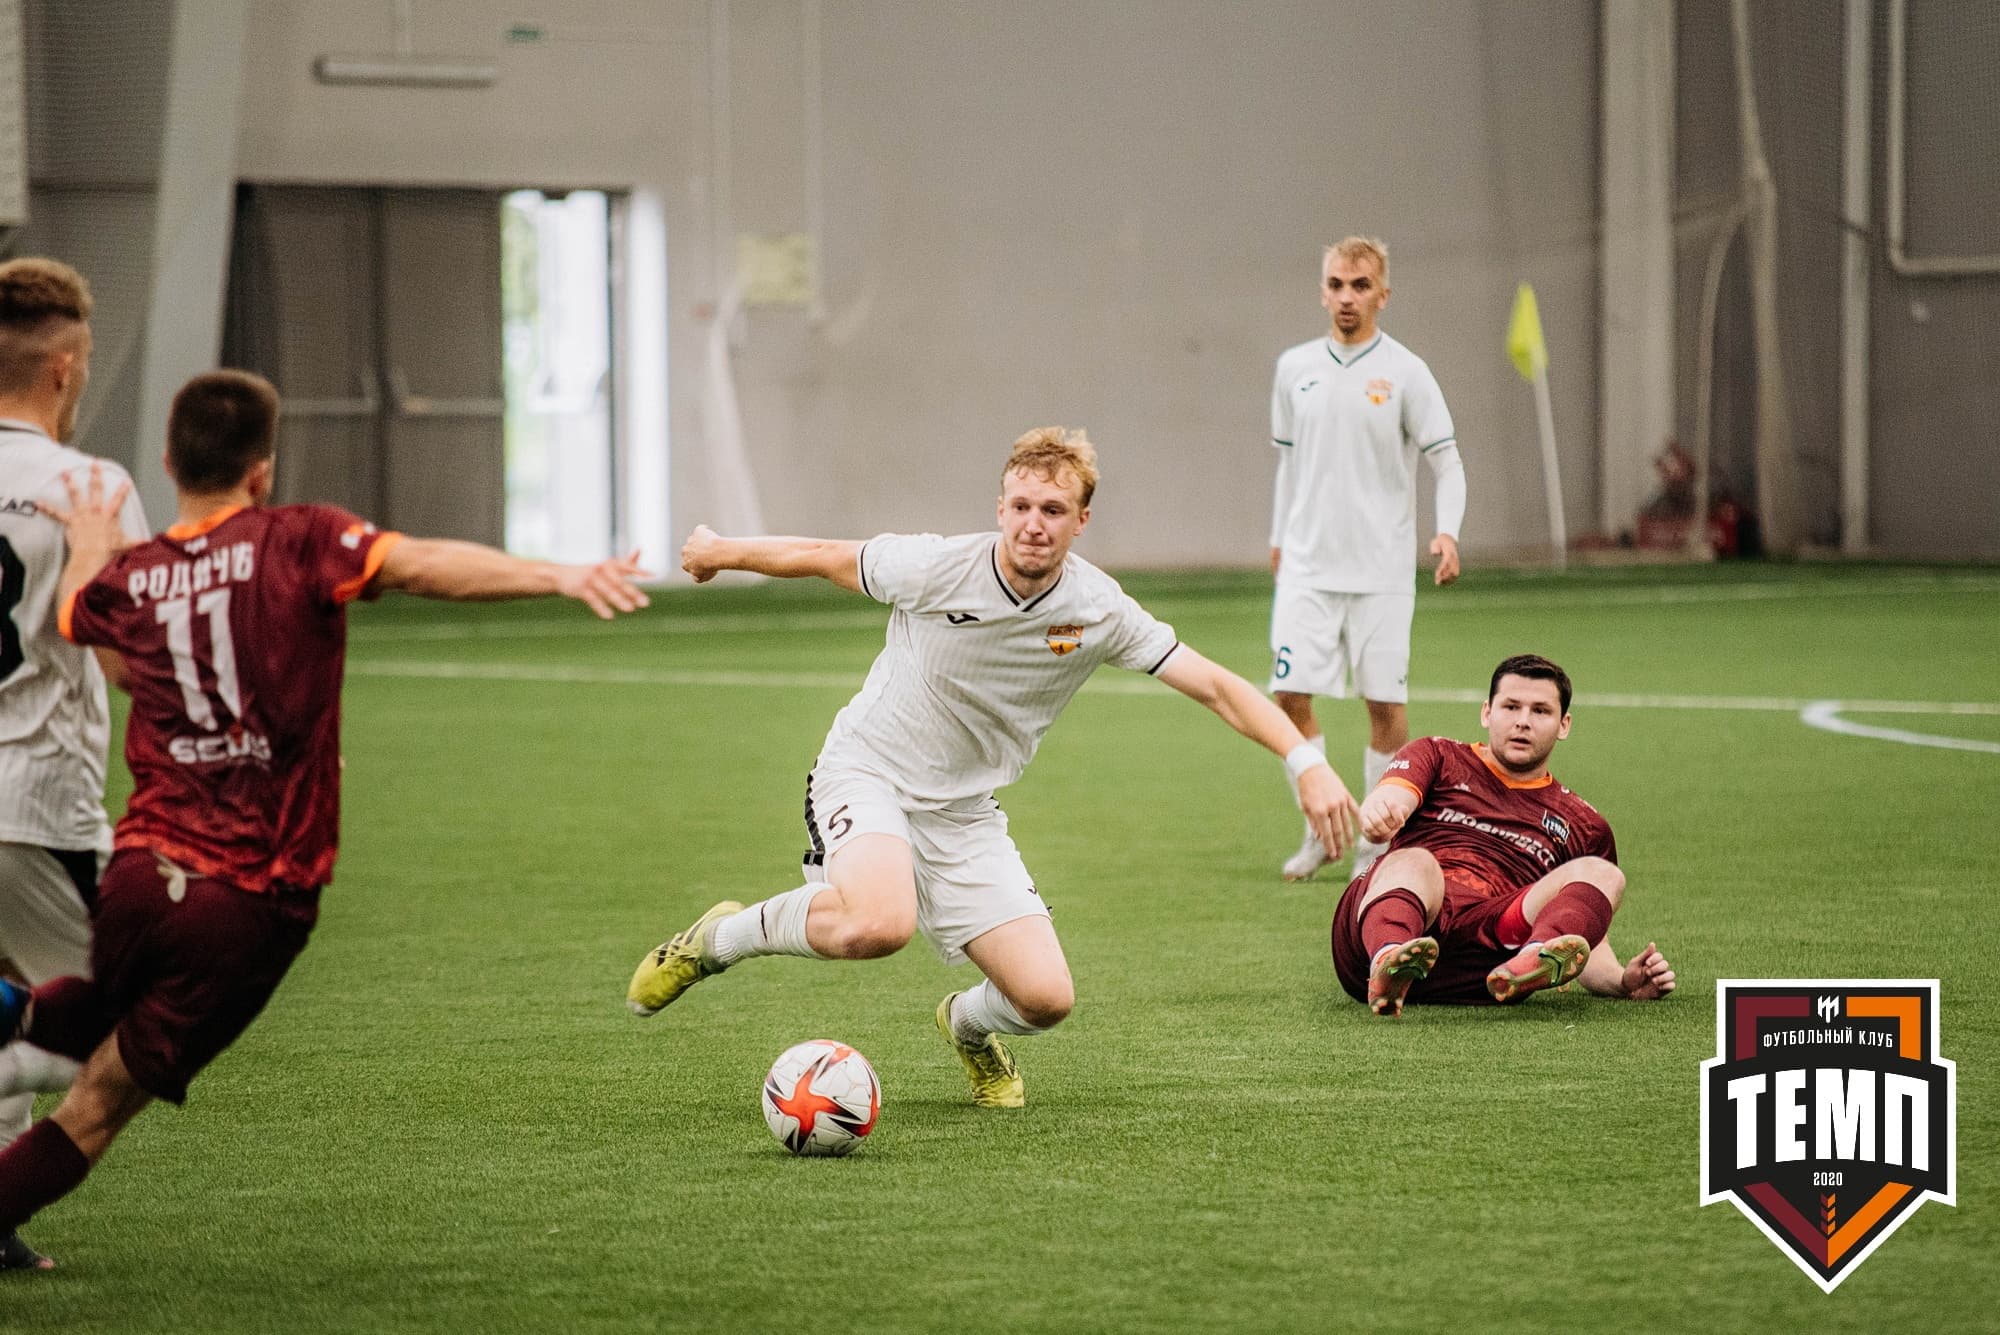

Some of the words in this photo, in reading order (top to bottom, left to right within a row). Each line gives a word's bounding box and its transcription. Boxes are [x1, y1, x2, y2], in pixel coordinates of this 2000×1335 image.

[155, 587, 243, 731] 11
[1274, 645, 1292, 679] 6
[828, 804, 853, 840] 5
